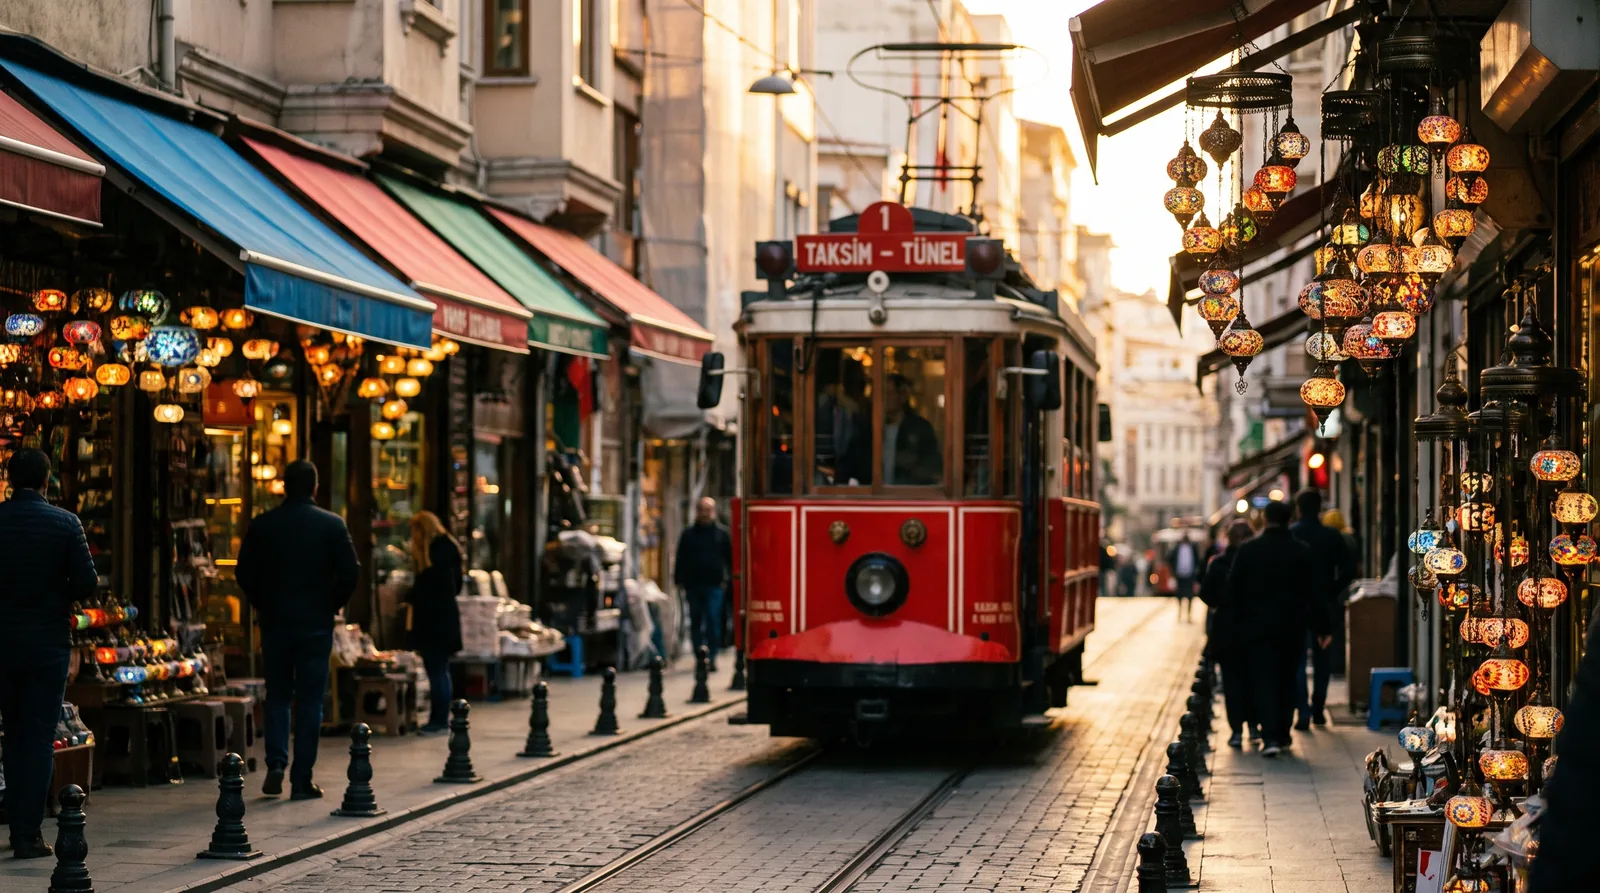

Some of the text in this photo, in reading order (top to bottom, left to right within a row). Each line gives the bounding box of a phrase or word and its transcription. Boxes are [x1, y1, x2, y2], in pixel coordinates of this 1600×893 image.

[879, 205, 890, 231] 1
[804, 237, 873, 266] TAKSİM
[901, 236, 965, 265] TÜNEL
